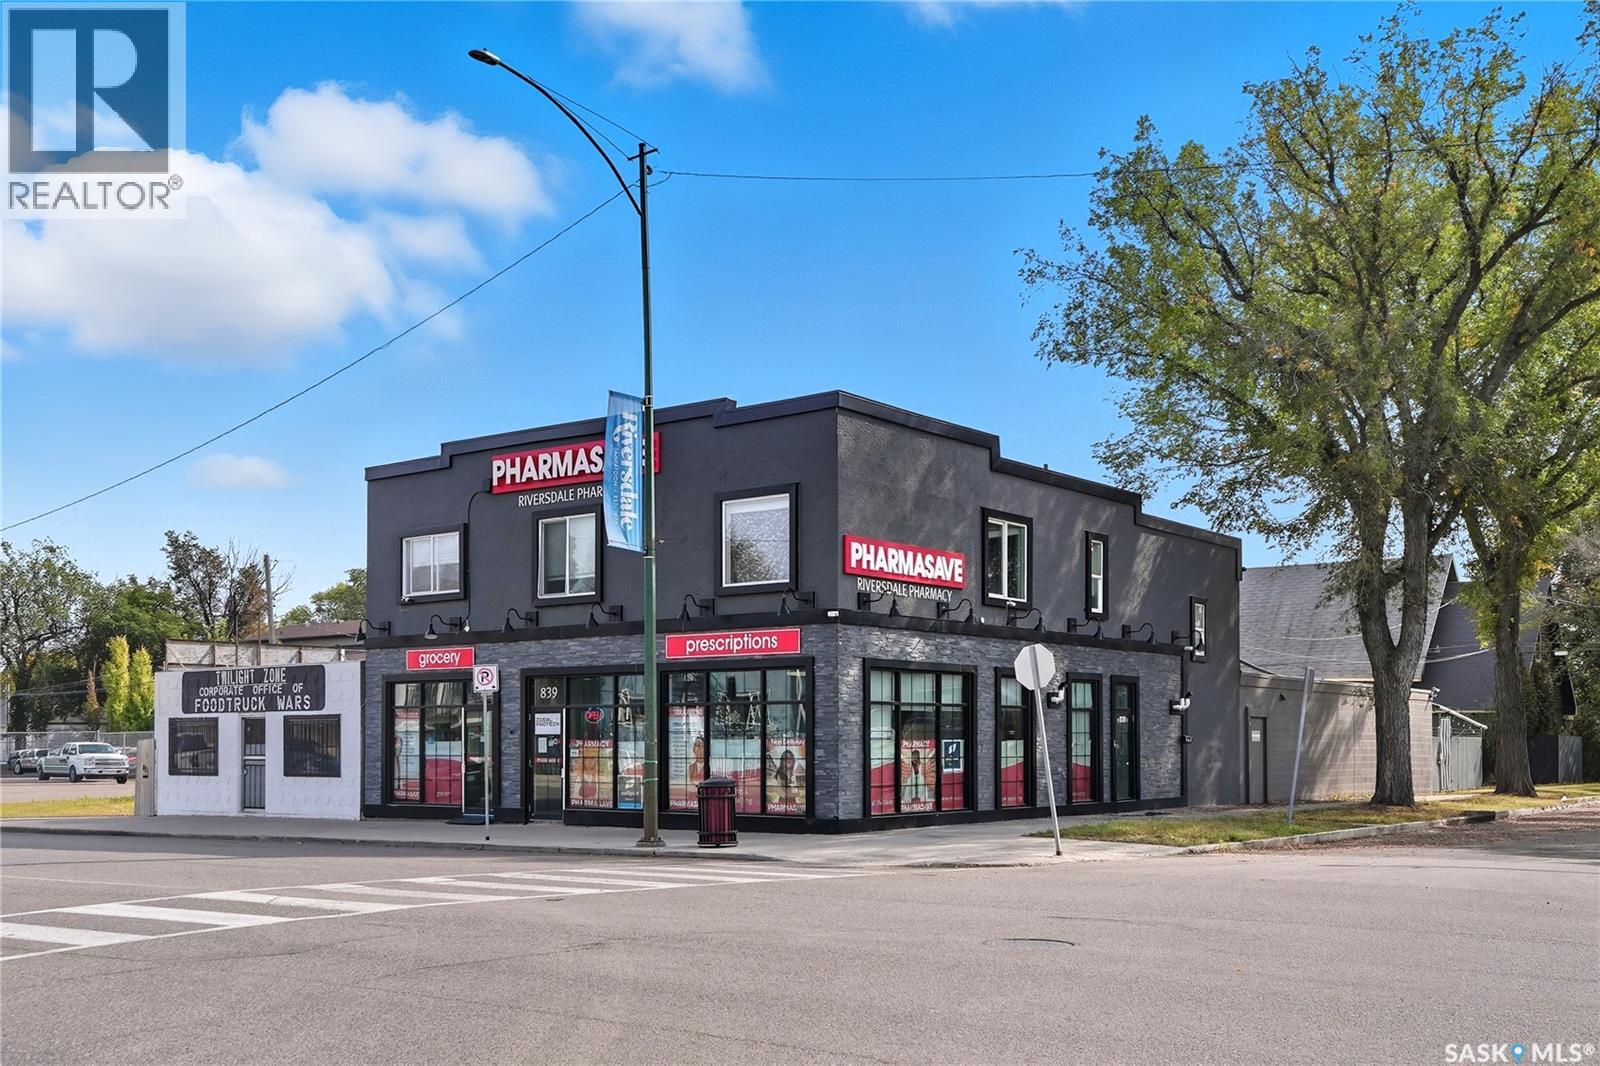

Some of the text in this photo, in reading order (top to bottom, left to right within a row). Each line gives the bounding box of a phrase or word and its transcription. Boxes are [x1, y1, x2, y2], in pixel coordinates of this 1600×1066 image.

[492, 438, 646, 487] PHARMAS
[613, 411, 638, 531] Riversdale
[518, 485, 603, 507] RIVERSDALE PHAR
[850, 541, 963, 583] PHARMASAVE
[857, 577, 953, 602] RIVERSDALE PHARMACY
[686, 634, 778, 655] prescriptions
[419, 652, 461, 668] grocery
[216, 667, 287, 685] TWILIGHT ZONE
[199, 683, 303, 697] CORPORATE OFFICE OF
[540, 687, 558, 699] 839
[194, 695, 311, 712] FOODTRUCK WARS
